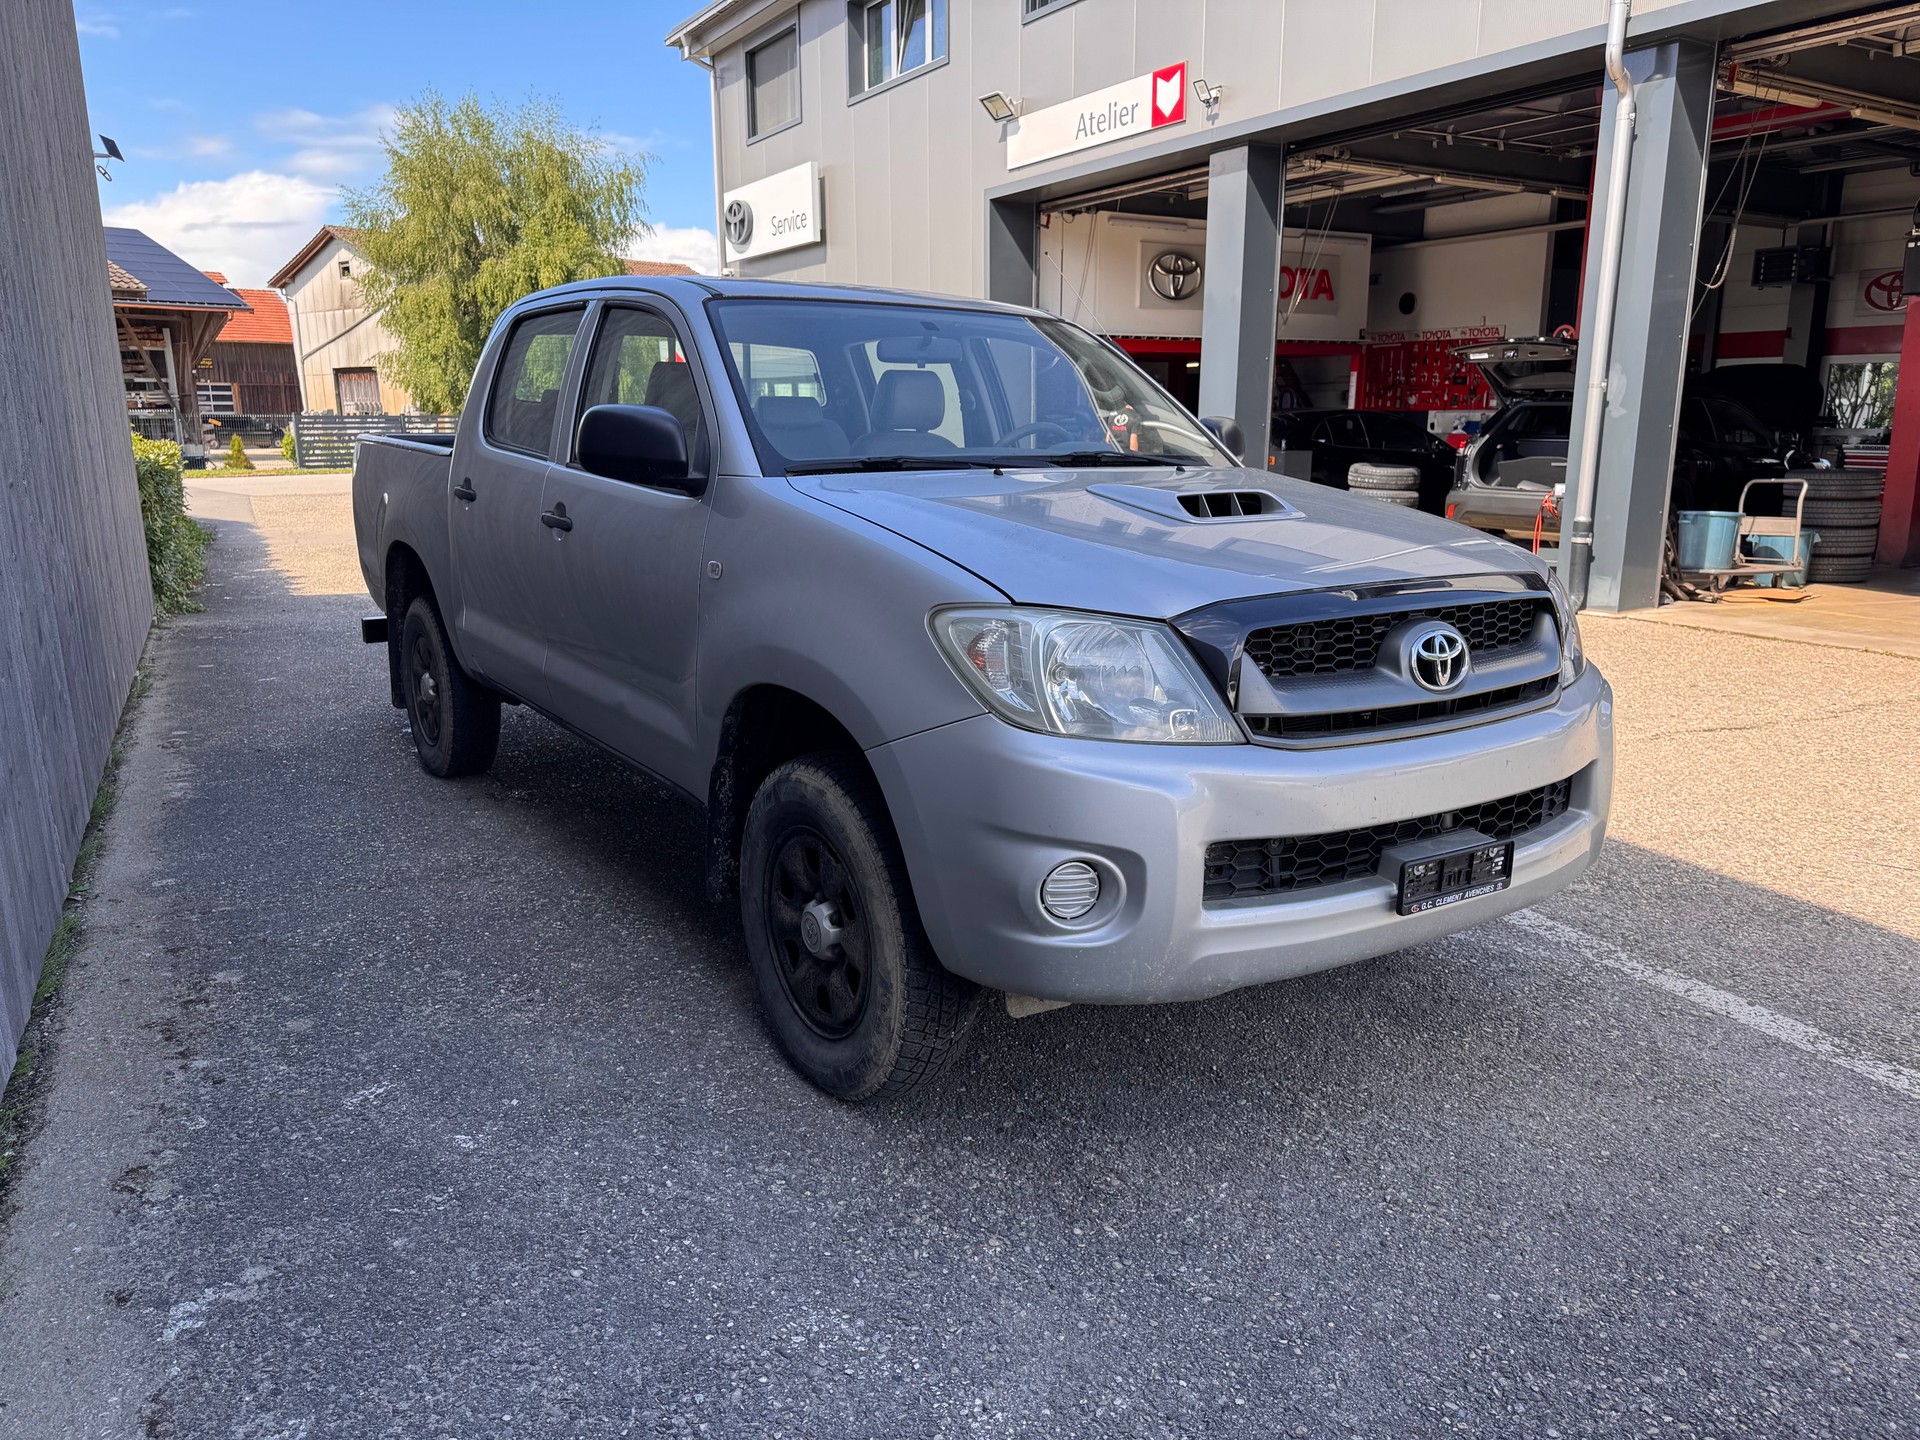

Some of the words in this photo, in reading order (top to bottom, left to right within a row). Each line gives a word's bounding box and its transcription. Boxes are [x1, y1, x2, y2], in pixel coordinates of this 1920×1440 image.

[1075, 101, 1139, 140] Atelier
[771, 209, 807, 237] Service
[1376, 333, 1405, 343] TOYOTA
[1422, 330, 1451, 340] TOYOTA
[1468, 327, 1500, 337] TOYOTA
[1436, 893, 1462, 906] CLEMENT
[1464, 885, 1494, 898] AVENCHES
